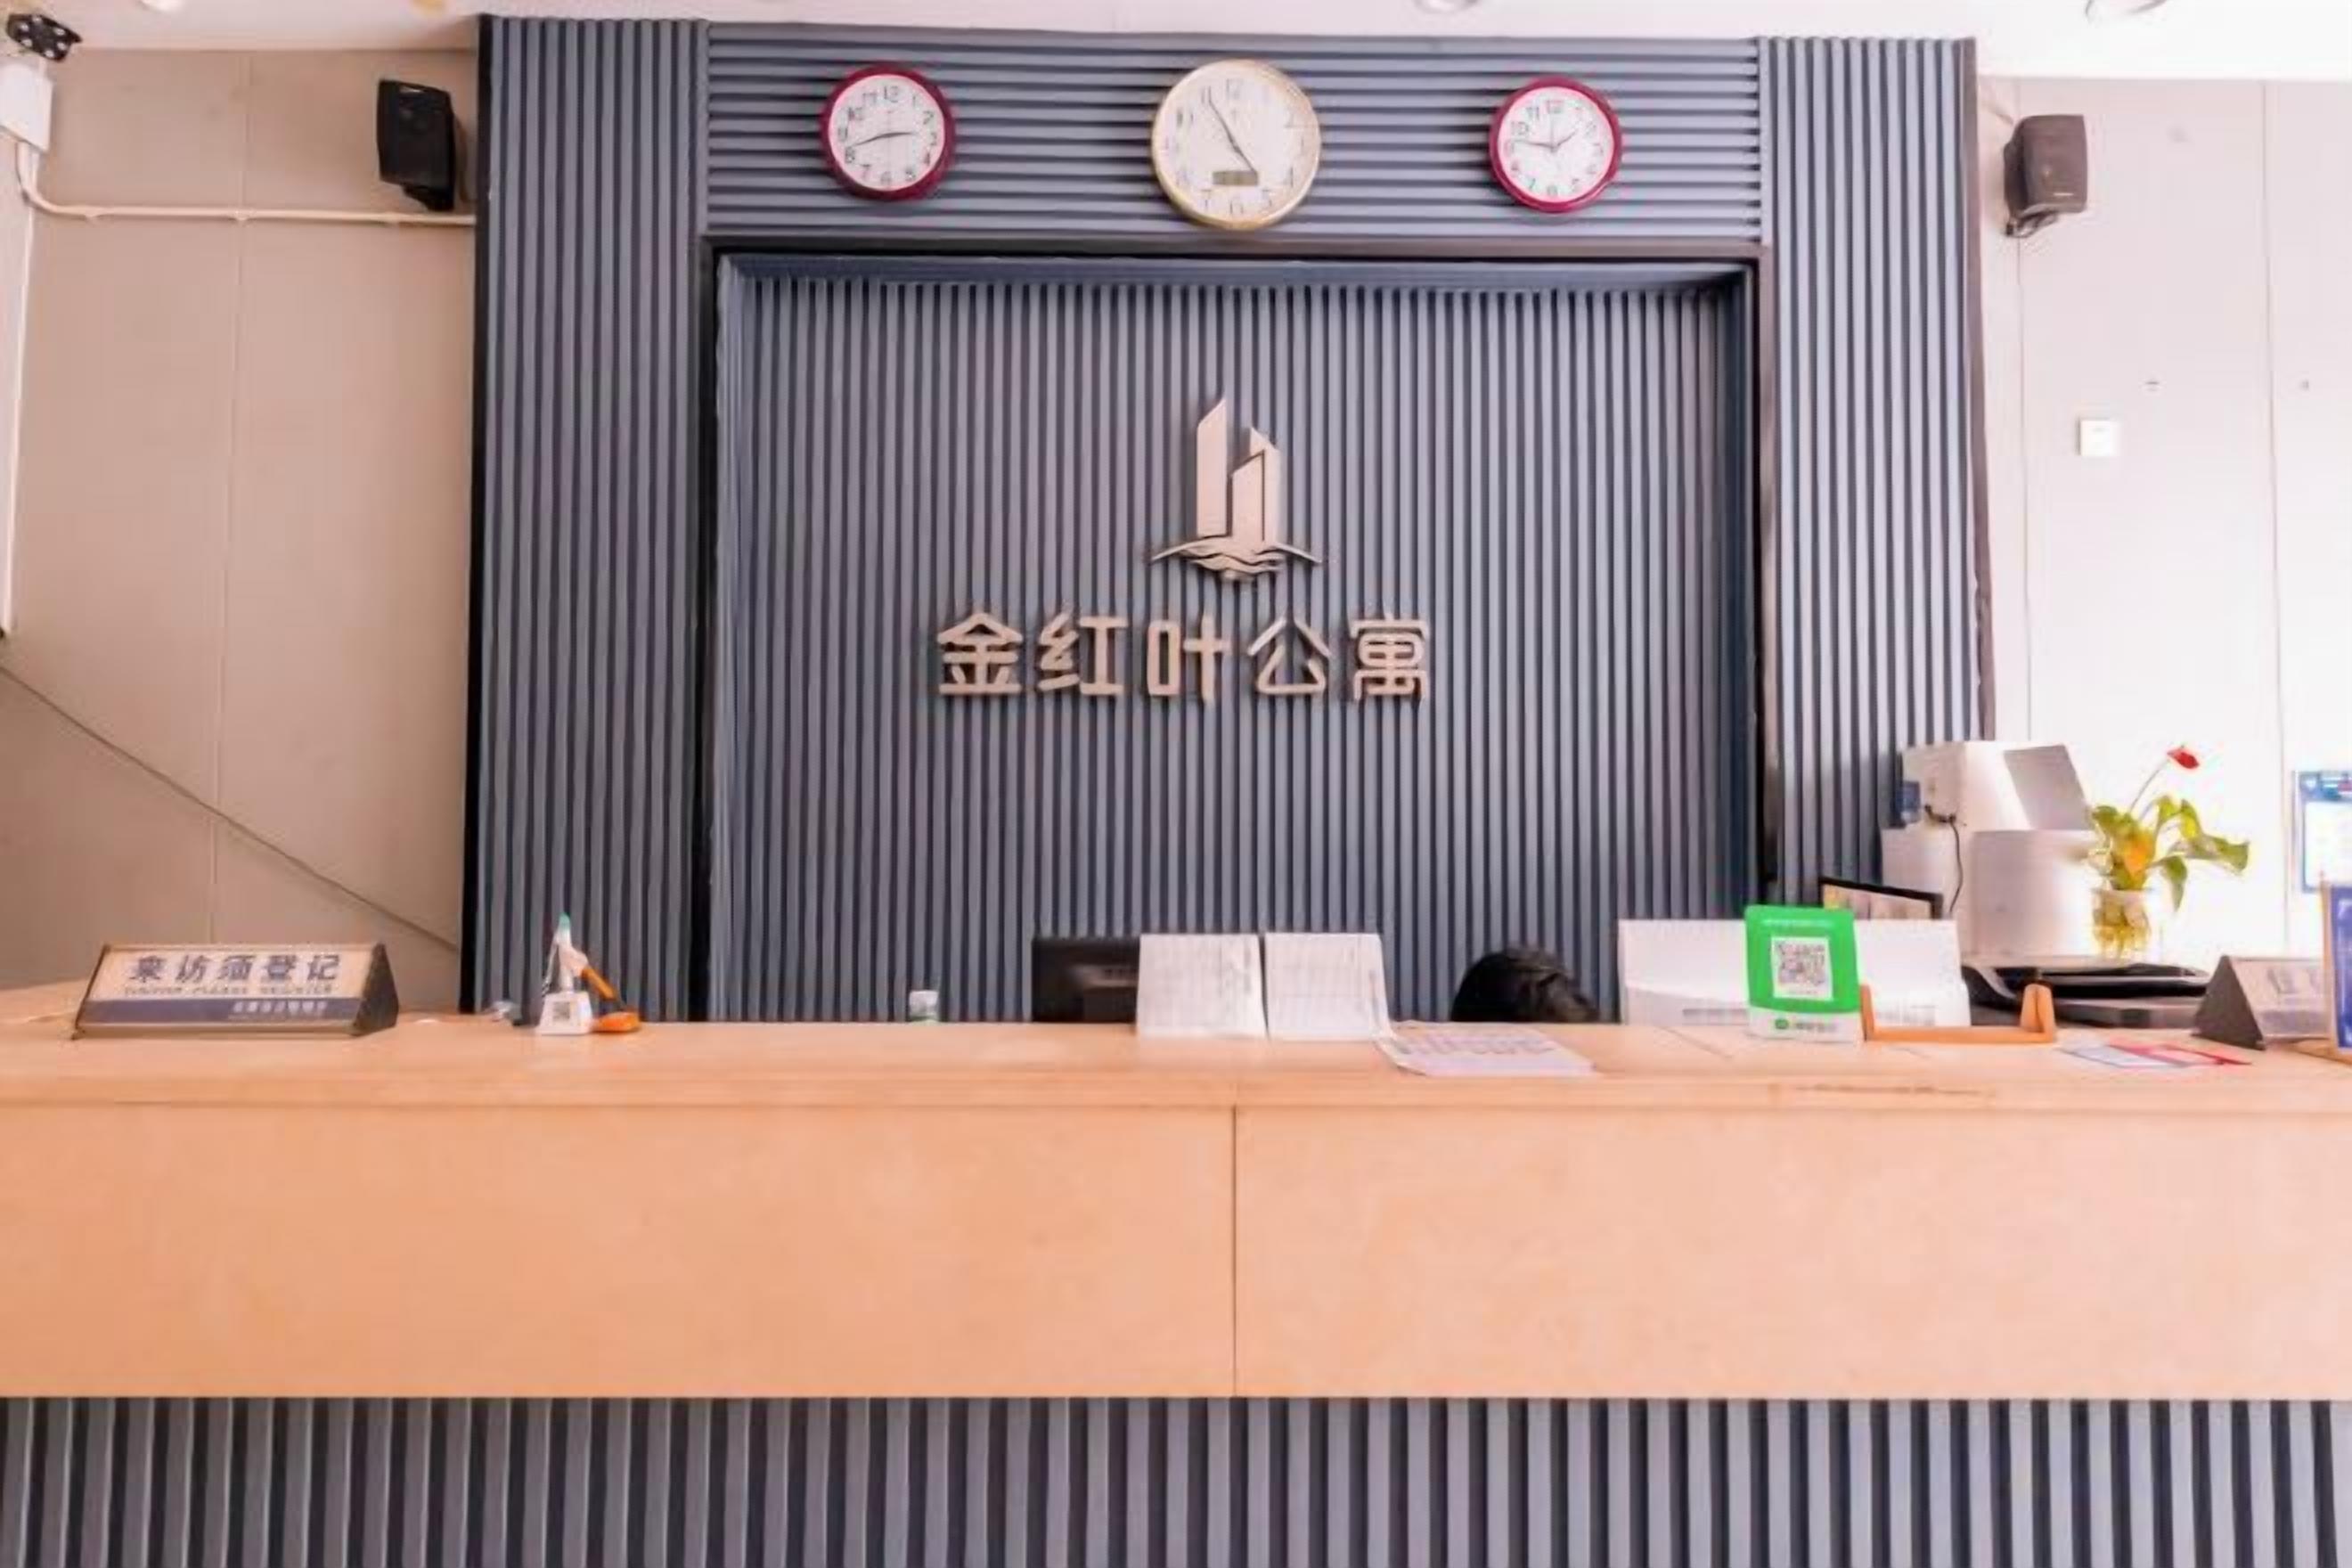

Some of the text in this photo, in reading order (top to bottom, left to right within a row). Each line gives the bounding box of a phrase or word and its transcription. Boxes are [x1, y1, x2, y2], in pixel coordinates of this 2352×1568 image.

[937, 611, 1431, 702] 金红叶公寓
[129, 954, 340, 983] 来访须登记
